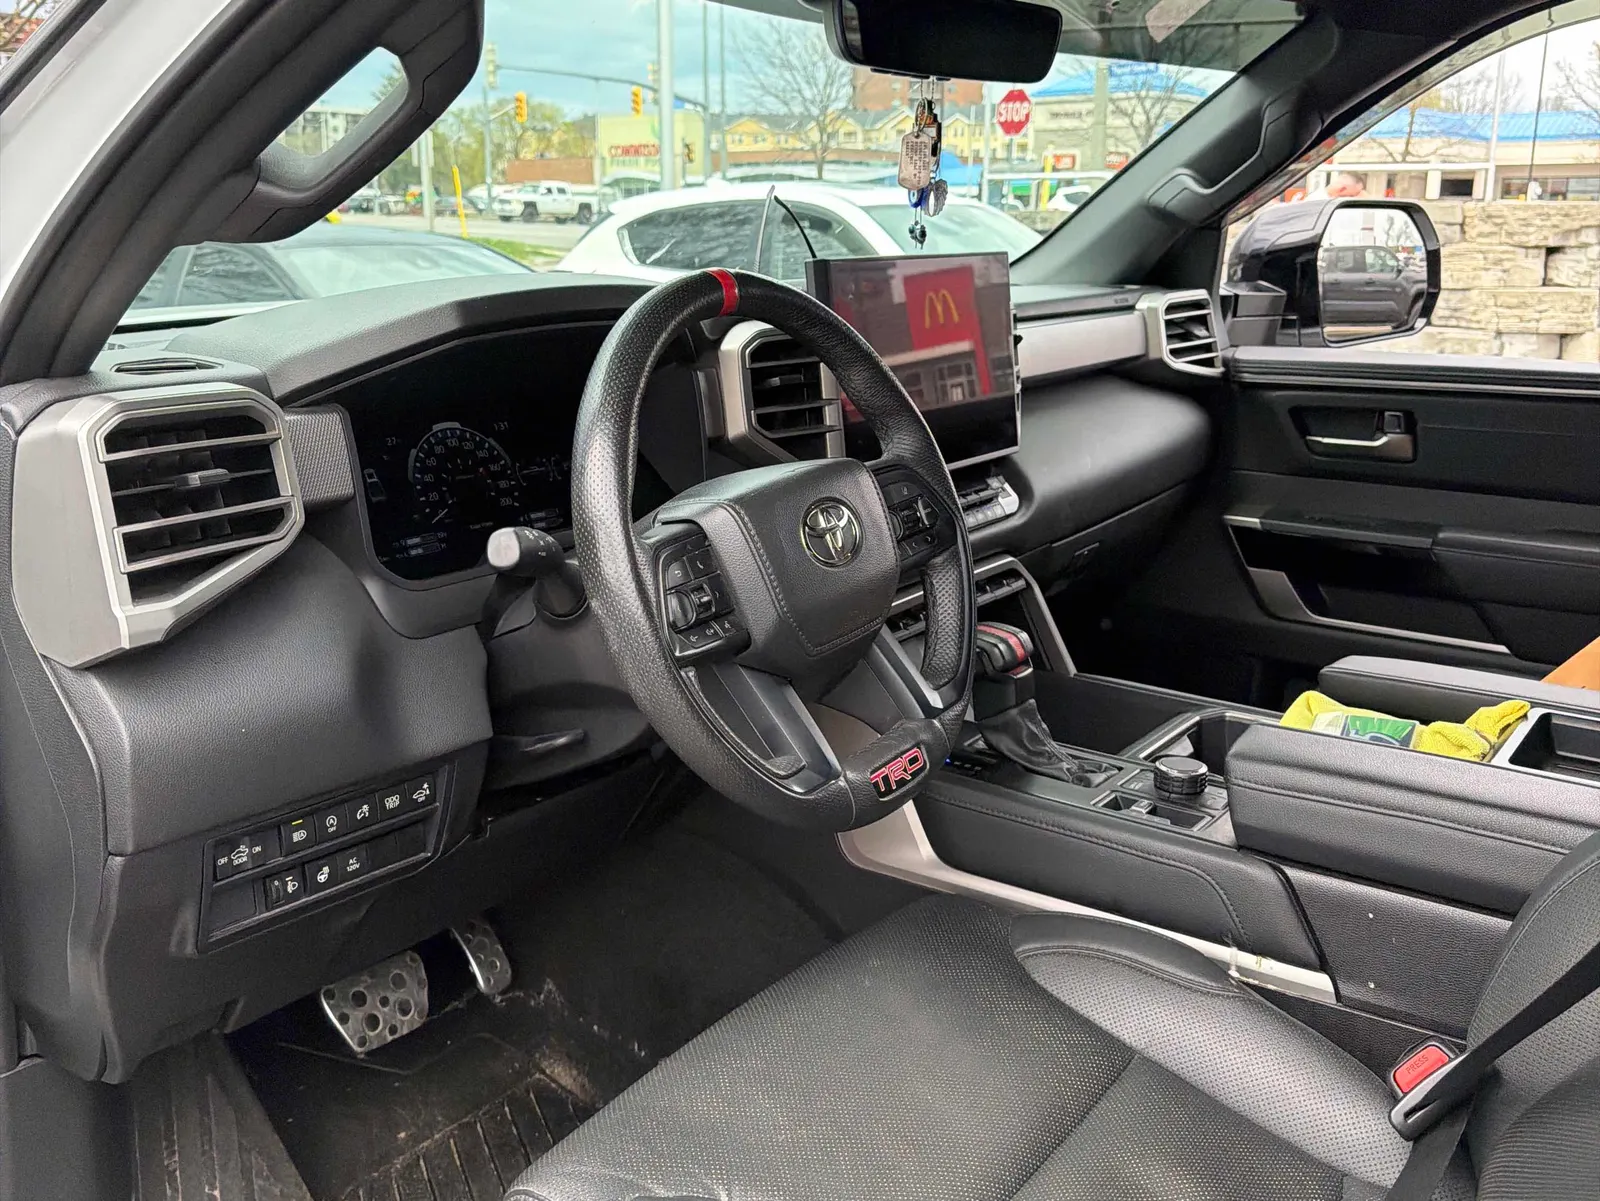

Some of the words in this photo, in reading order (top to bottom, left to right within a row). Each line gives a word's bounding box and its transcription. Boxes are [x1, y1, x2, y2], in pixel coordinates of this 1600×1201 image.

[999, 101, 1030, 122] STOP
[446, 438, 460, 448] 100
[461, 440, 475, 450] 120
[426, 457, 437, 467] 60
[424, 473, 435, 483] 40
[428, 491, 439, 501] 20
[870, 747, 924, 791] TRD
[384, 794, 400, 805] ODO
[385, 800, 400, 810] TRIP
[252, 845, 262, 854] ON
[217, 856, 229, 866] OFF
[232, 855, 248, 866] DOOR
[349, 857, 358, 865] AC
[346, 862, 361, 872] 120V
[1405, 1055, 1429, 1074] PRESS
